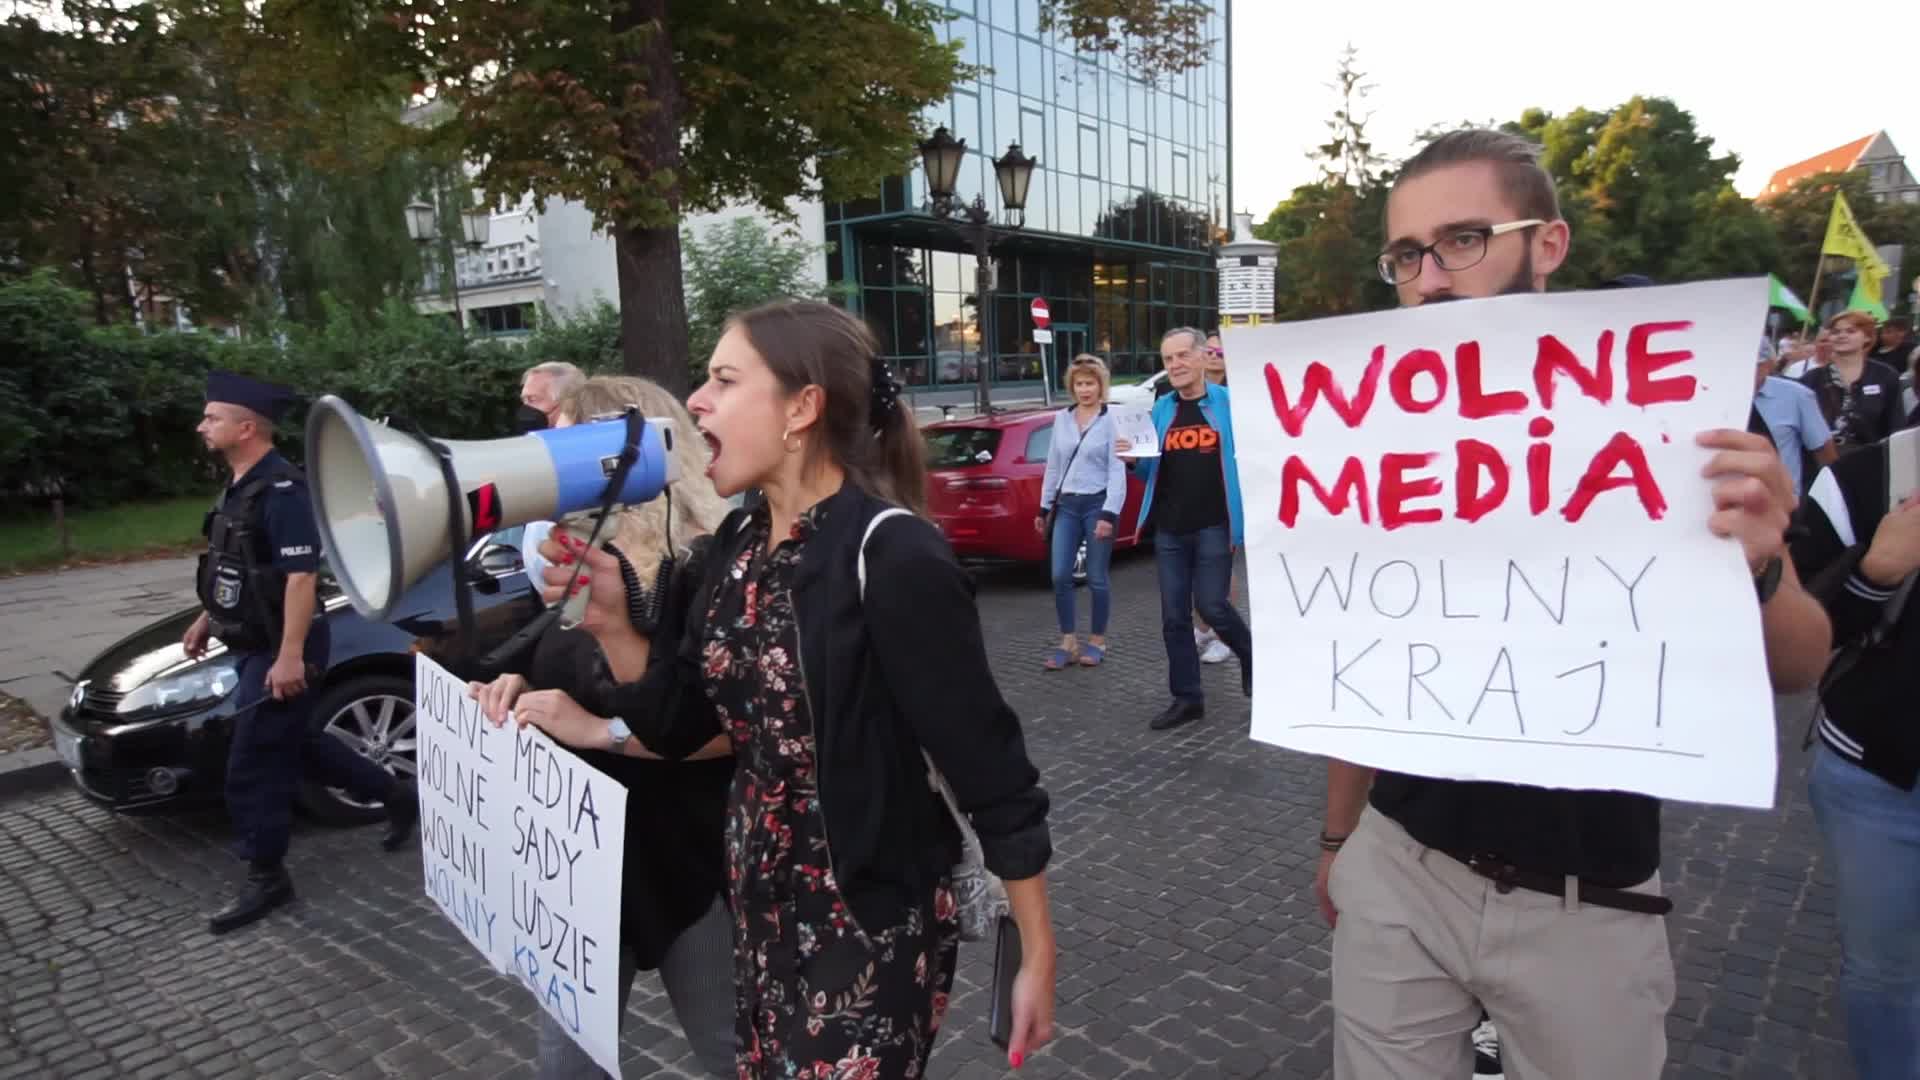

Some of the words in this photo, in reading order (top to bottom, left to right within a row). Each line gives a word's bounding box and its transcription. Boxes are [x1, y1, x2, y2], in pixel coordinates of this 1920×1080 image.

[1264, 320, 1697, 437] WOLNE
[1165, 426, 1217, 451] KOD
[280, 545, 313, 557] POLICJA
[1280, 552, 1657, 631] WOLNY
[421, 664, 496, 764] WOLNE
[513, 729, 600, 849] MEDIA
[421, 731, 489, 830] WOLNE
[421, 800, 487, 895] WOLNI
[511, 871, 597, 994] LUDZIE
[425, 860, 496, 952] WOLNY
[513, 935, 579, 1034] KRAJ
